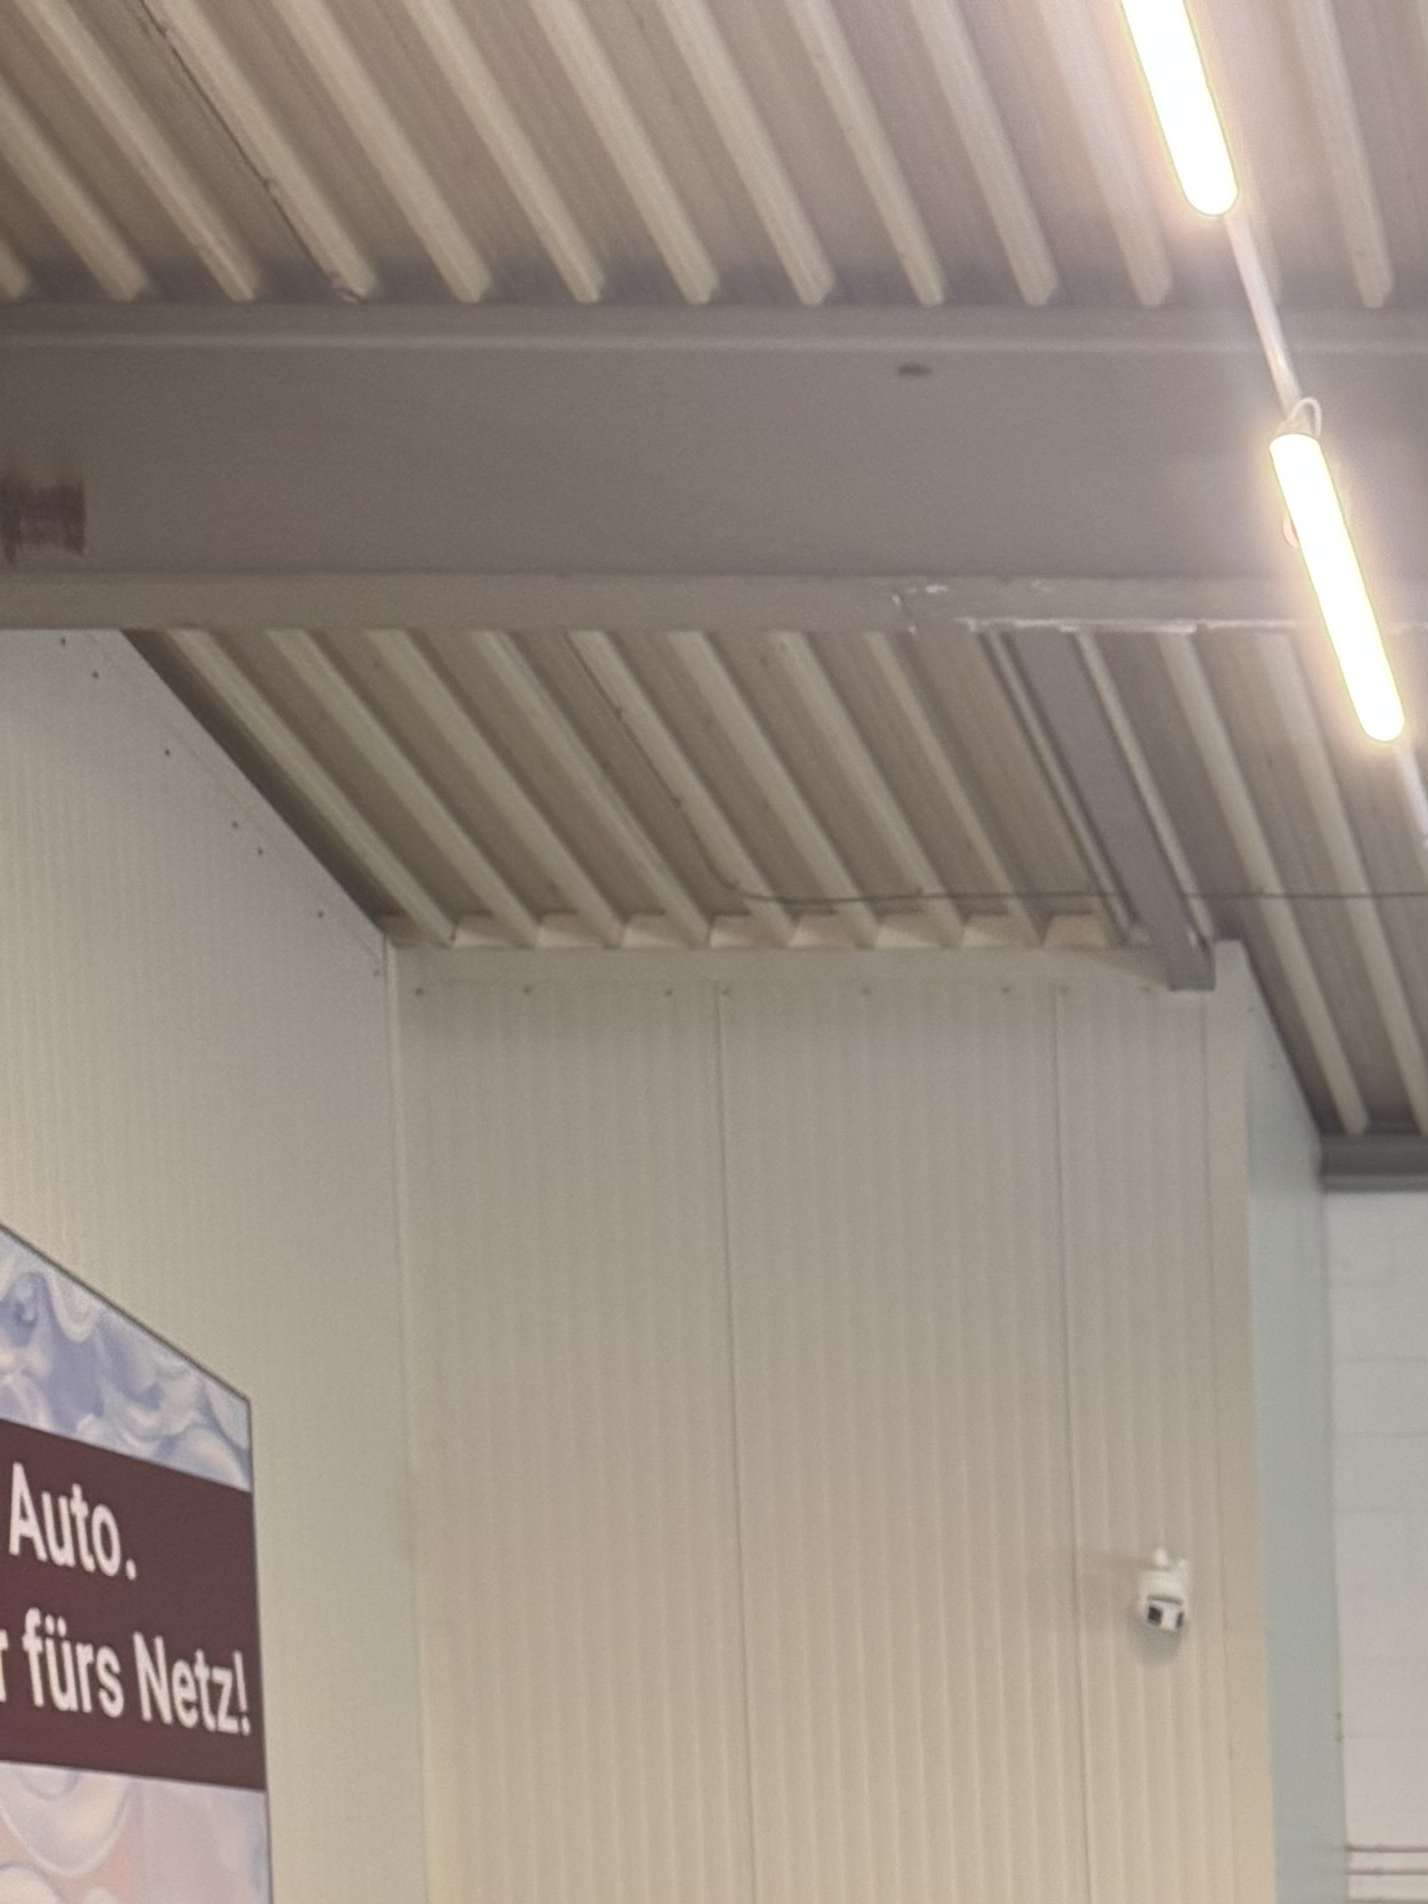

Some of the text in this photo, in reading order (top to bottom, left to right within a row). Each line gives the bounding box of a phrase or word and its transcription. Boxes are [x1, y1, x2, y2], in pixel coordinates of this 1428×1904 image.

[9, 1462, 137, 1580] Auto.
[22, 1607, 124, 1719] fürs
[133, 1631, 251, 1736] Netz!
